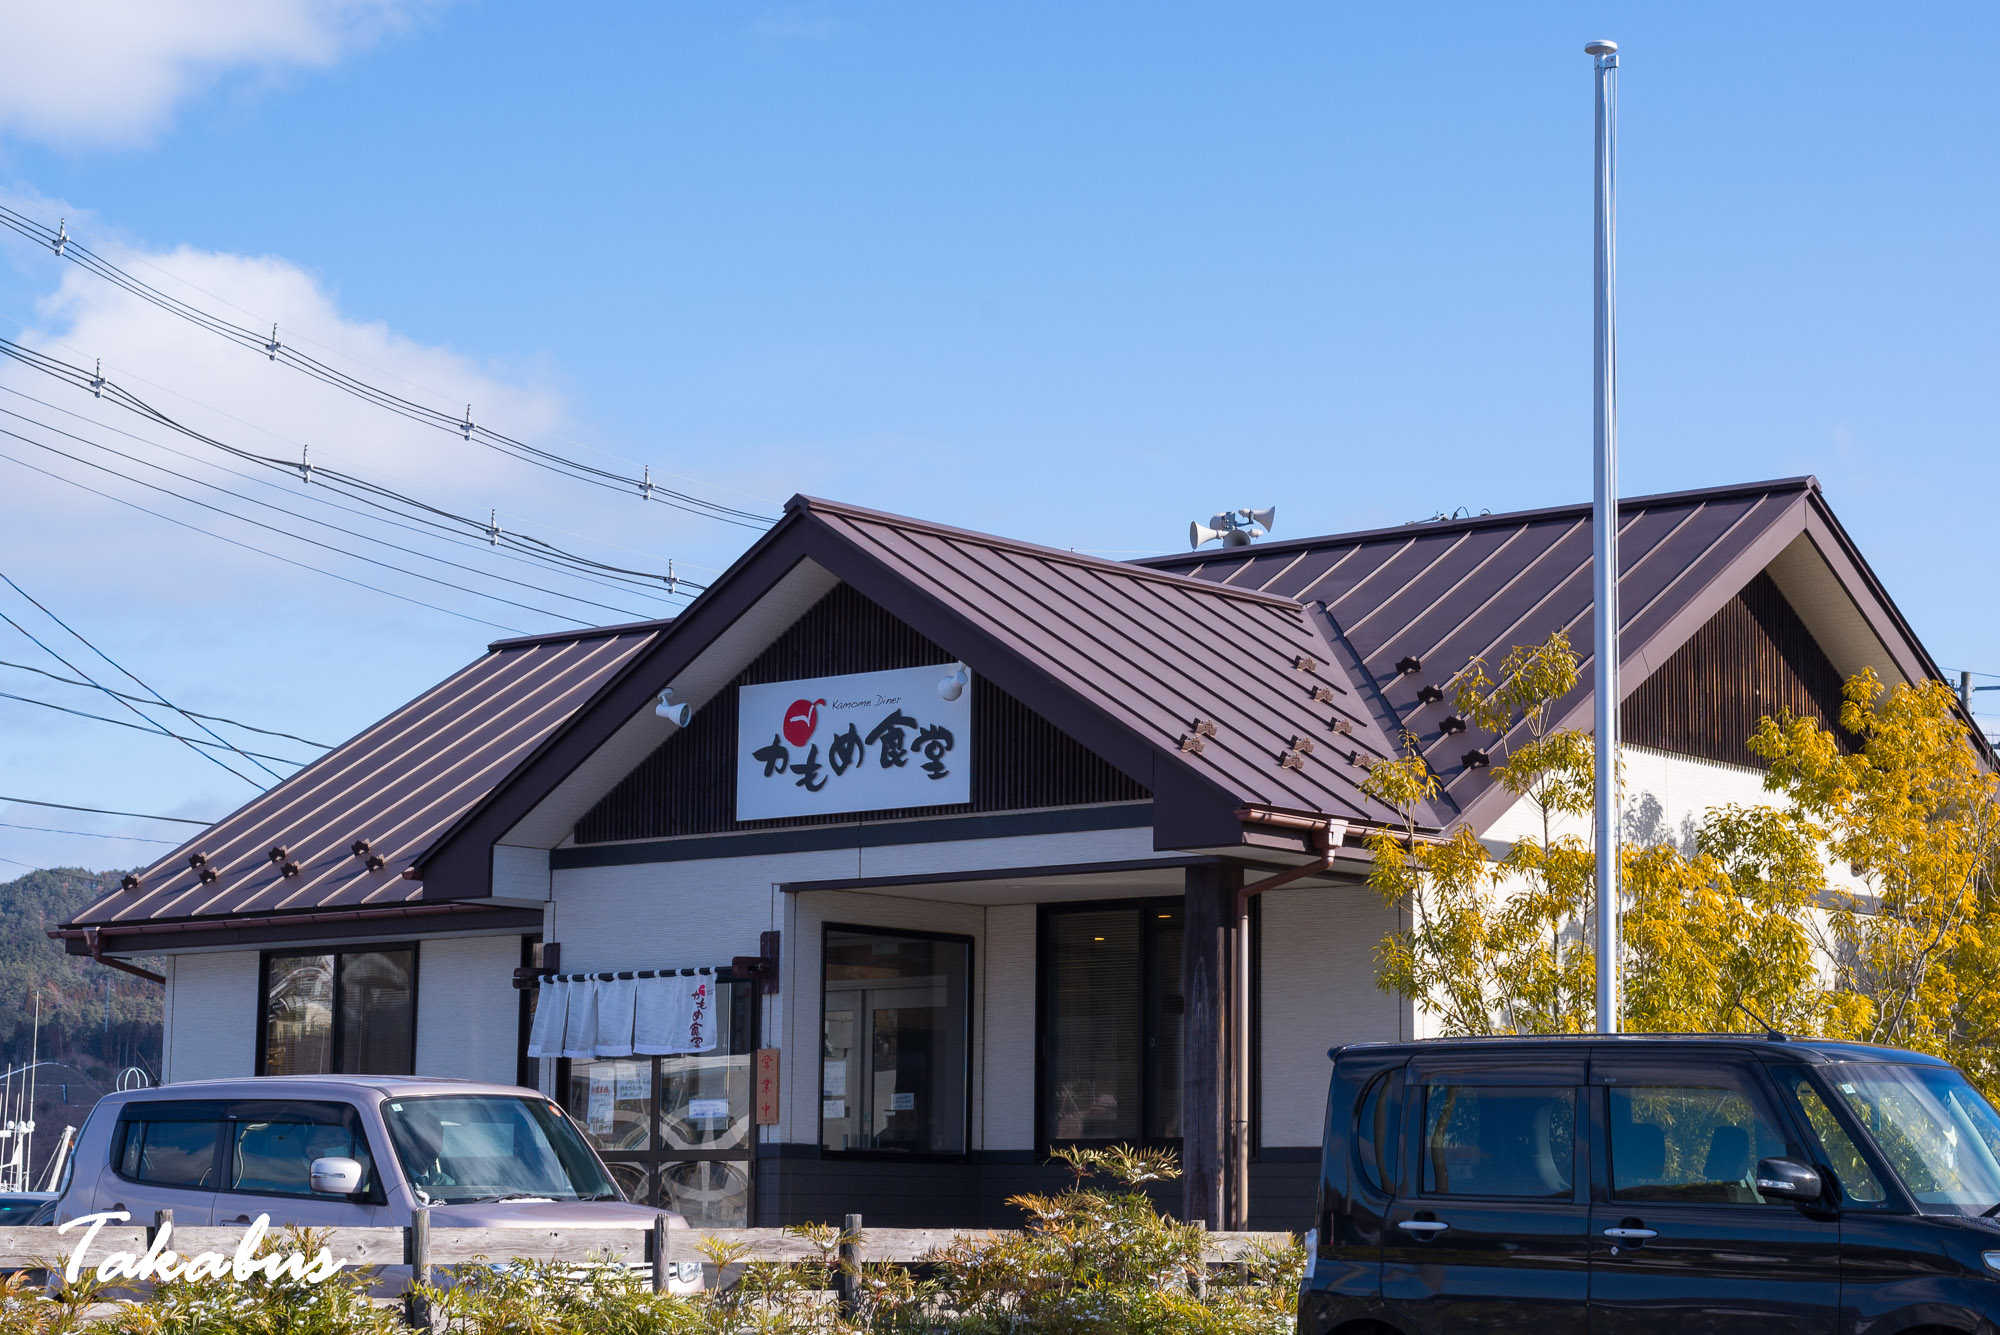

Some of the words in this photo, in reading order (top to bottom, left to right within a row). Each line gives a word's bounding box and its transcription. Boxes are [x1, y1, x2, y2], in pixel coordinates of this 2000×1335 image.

[832, 699, 872, 710] Kamome
[874, 694, 902, 707] Diner
[752, 708, 954, 792] かもめ食堂
[689, 990, 707, 1049] かもめ食堂
[761, 1054, 773, 1122] 営業中
